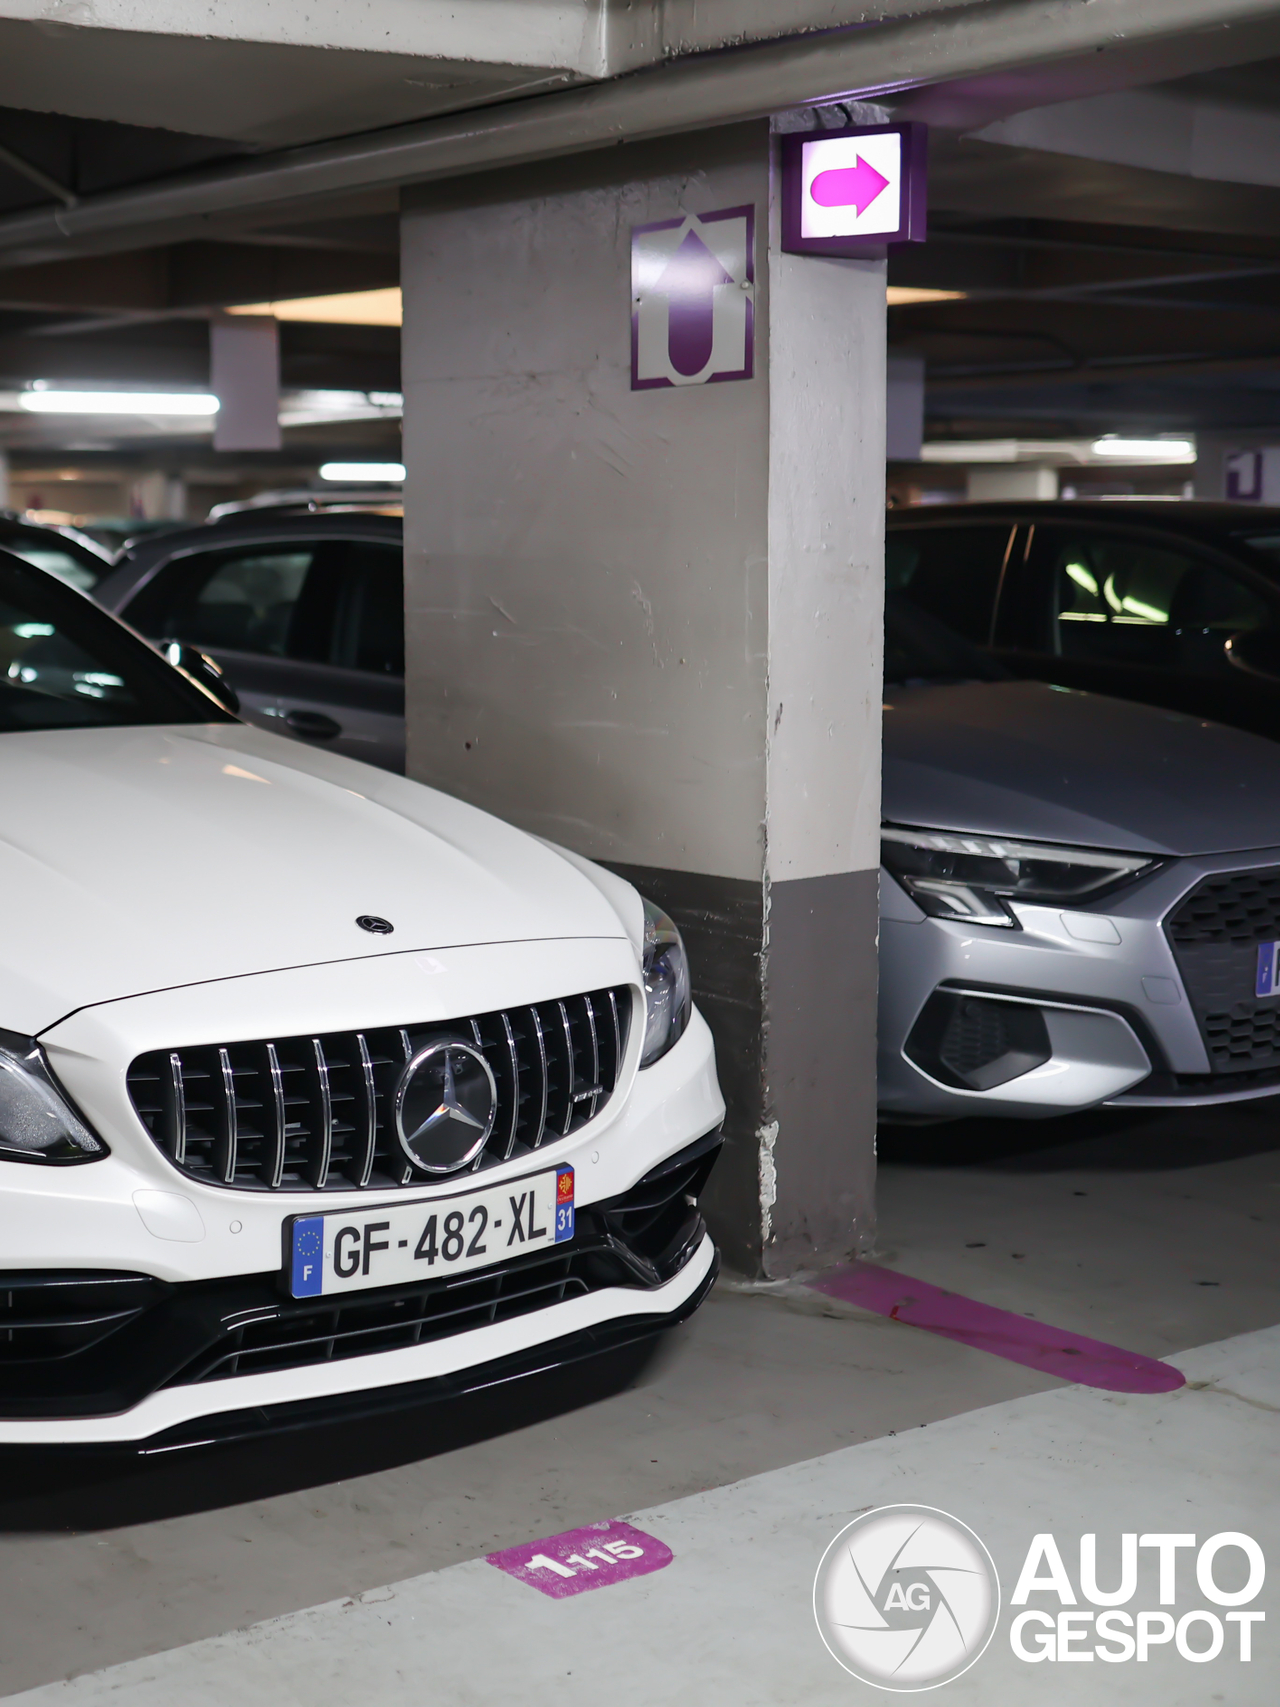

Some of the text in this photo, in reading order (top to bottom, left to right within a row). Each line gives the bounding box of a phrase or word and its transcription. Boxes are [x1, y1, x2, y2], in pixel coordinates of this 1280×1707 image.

[557, 1206, 573, 1231] 31
[333, 1190, 547, 1279] GF-482-XL
[303, 1265, 313, 1281] F
